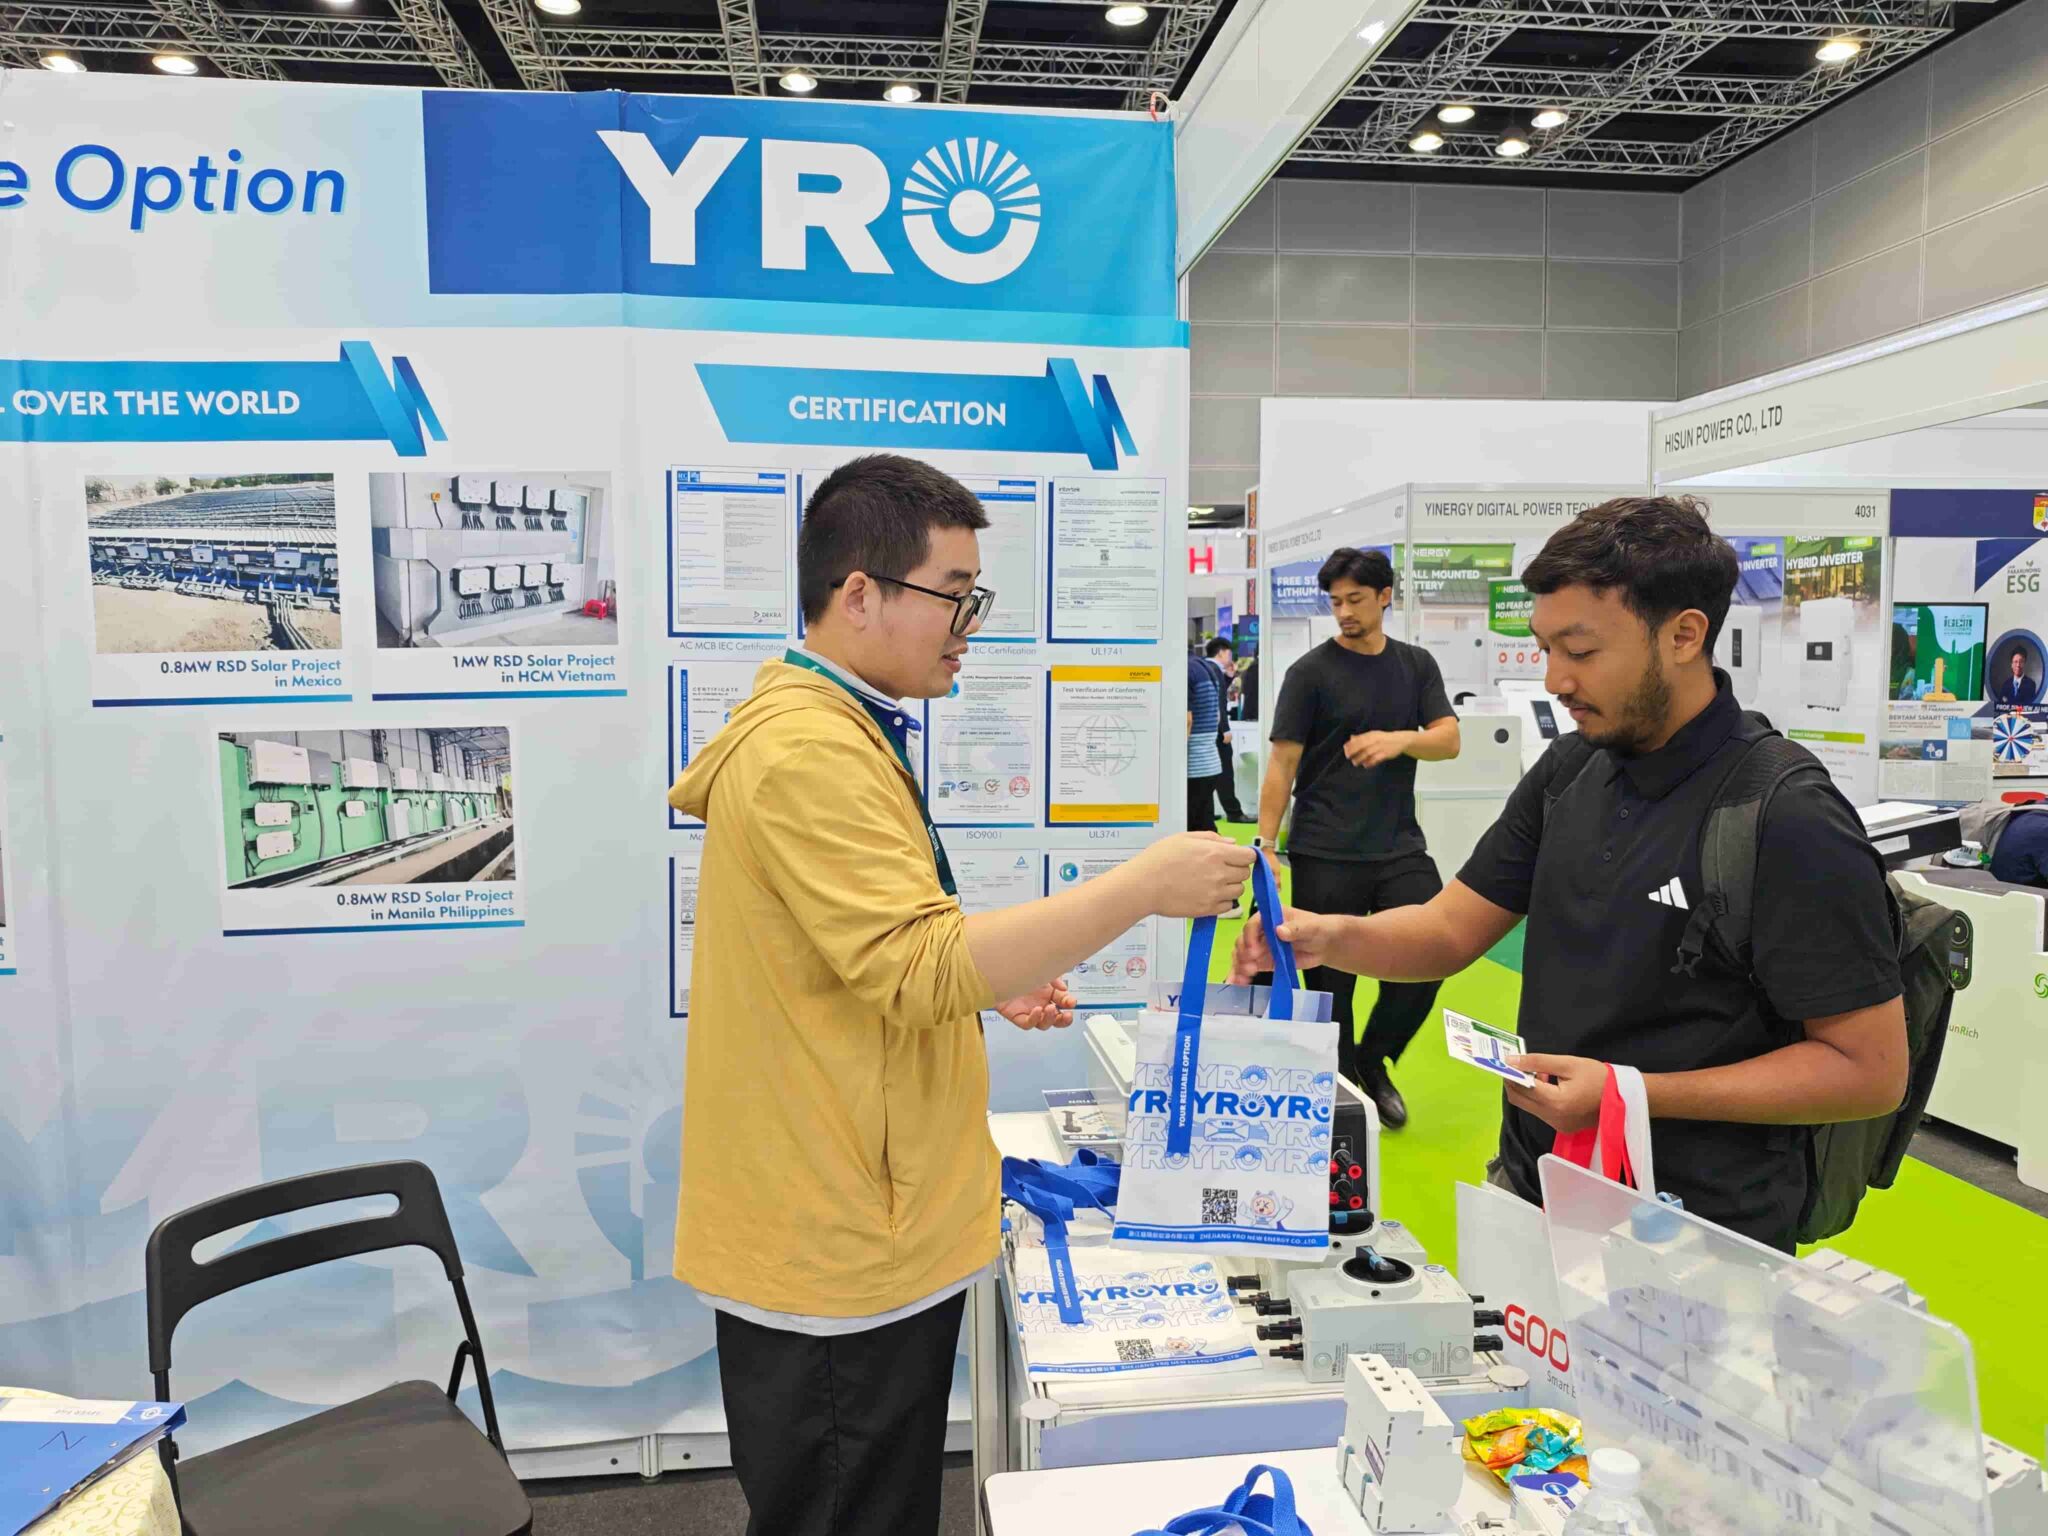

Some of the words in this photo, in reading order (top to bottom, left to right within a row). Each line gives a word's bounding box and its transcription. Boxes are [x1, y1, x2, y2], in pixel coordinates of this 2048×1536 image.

[54, 143, 347, 231] Option
[596, 130, 1041, 285] YRO
[113, 390, 179, 415] THE
[185, 390, 300, 415] WORLD
[788, 396, 1007, 428] CERTIFICATION
[1665, 428, 1694, 454] HISUN
[1696, 418, 1734, 446] POWER
[1761, 405, 1783, 430] LTD
[1425, 503, 1473, 517] YINERGY
[1476, 503, 1519, 516] DIGITAL
[1522, 503, 1563, 516] POWER
[1855, 504, 1876, 518] 4031
[1743, 557, 1778, 571] INVERTER
[1786, 556, 1818, 570] HYBRID
[1819, 551, 1864, 567] INVERTER
[1277, 576, 1302, 586] FREE
[1431, 569, 1480, 579] MOUNTED
[2006, 573, 2040, 594] ESG
[1277, 587, 1318, 597] LITHIUM
[679, 642, 693, 650] AC
[694, 642, 716, 650] MCB
[735, 642, 786, 651] Certification
[972, 646, 987, 654] IEC
[988, 646, 1037, 655] Certification
[1091, 648, 1123, 656] UL1741
[160, 660, 213, 674] 0.8MW
[216, 659, 247, 673] RSD
[250, 659, 287, 672] Solar
[291, 659, 341, 673] Project
[453, 655, 489, 668] 1MW
[493, 655, 523, 667] RSD
[527, 654, 563, 667] Solar
[567, 654, 615, 668] Project
[275, 676, 287, 687] in
[291, 675, 342, 687] Mexico
[501, 672, 514, 683] in
[518, 670, 554, 682] HCM
[558, 669, 616, 682] Vietnam
[966, 831, 1002, 840] ISO9001
[1089, 830, 1120, 839] UL3741
[336, 893, 387, 906] 0.8MW
[391, 892, 421, 904] RSD
[425, 890, 462, 903] Solar
[465, 890, 514, 903] Project
[371, 909, 383, 920] in
[388, 908, 435, 920] Manila
[439, 905, 514, 919] Philippines
[1949, 1024, 1979, 1040] unRich
[1183, 1035, 1192, 1066] OPTION
[1180, 1066, 1190, 1110] RELIABLE
[1179, 1109, 1188, 1128] YOUR
[1199, 1232, 1231, 1241] ZHEJIANG
[1247, 1233, 1263, 1242] NEW
[1263, 1234, 1290, 1244] ENERGY
[1546, 1370, 1571, 1394] Smart
